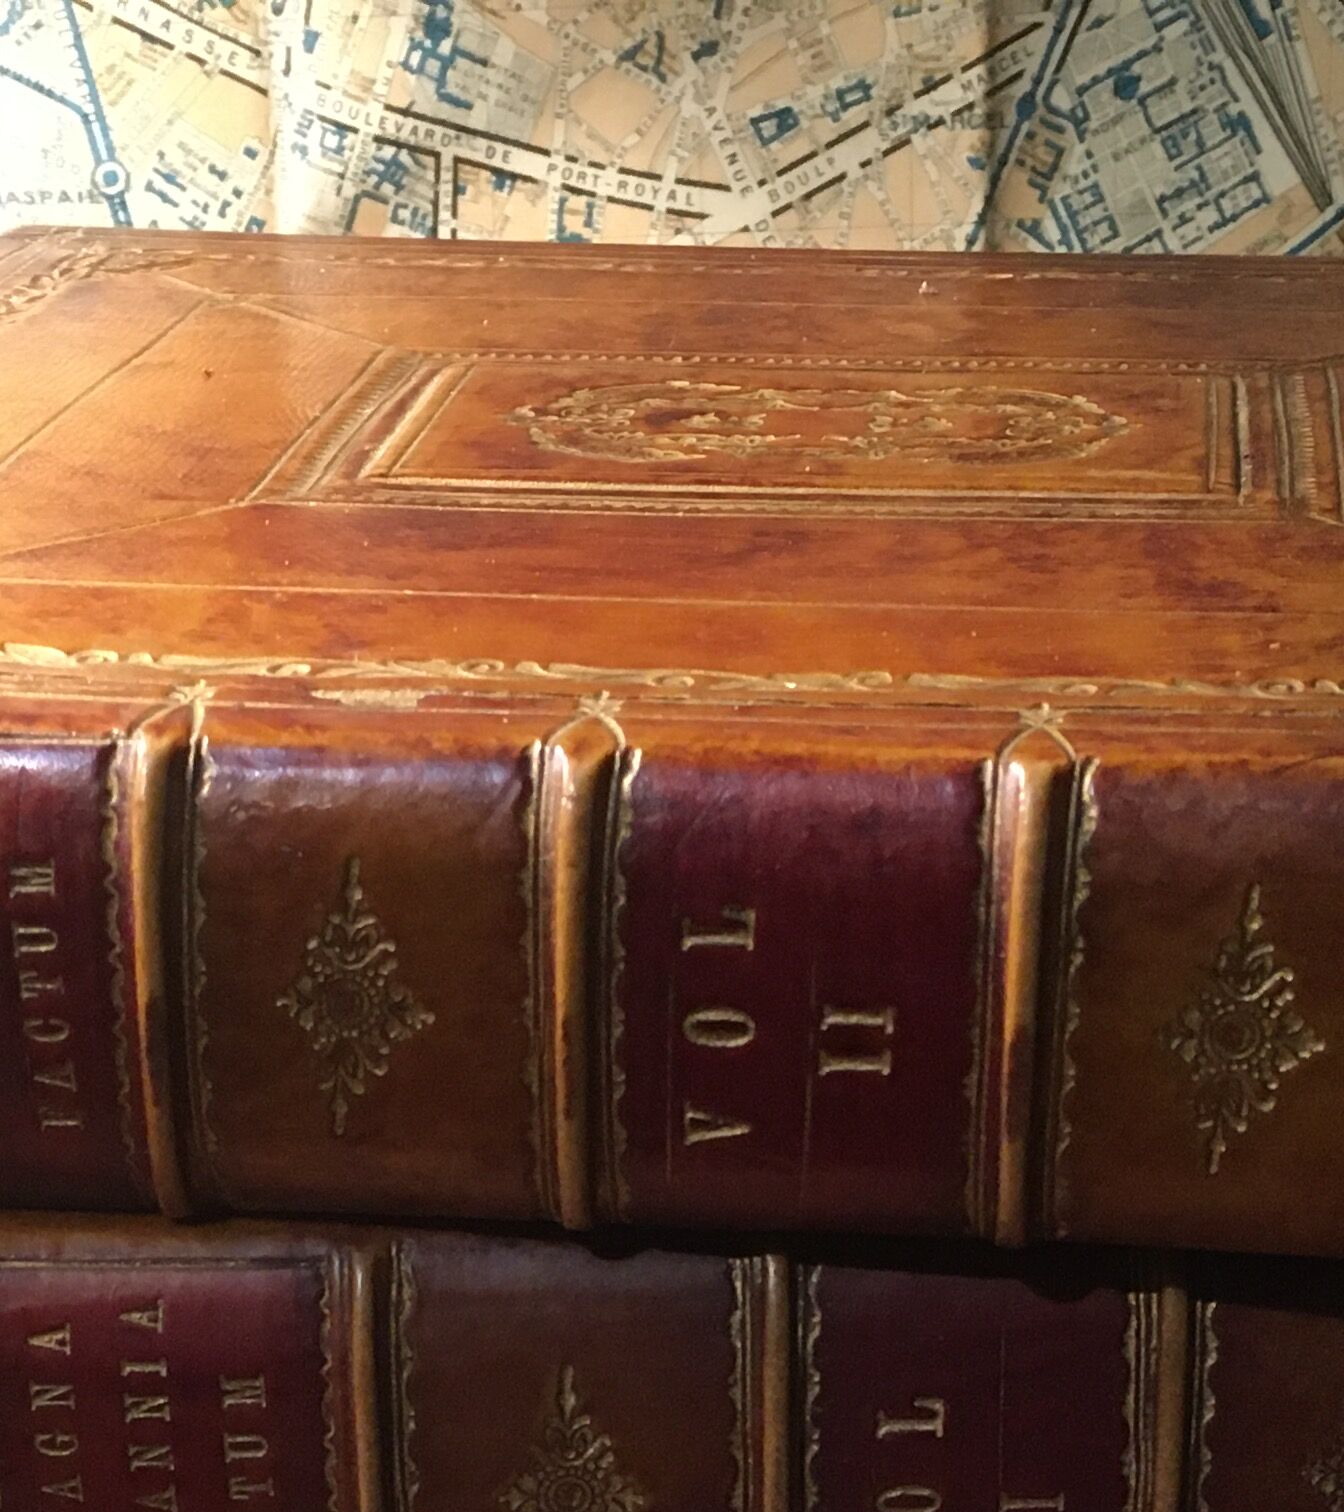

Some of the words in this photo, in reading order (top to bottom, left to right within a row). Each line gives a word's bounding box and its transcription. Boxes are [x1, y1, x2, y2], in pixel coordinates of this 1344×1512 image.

[484, 145, 512, 165] DE
[545, 161, 696, 208] PORT-ROYAL
[703, 104, 755, 199] AVENUE
[8, 857, 86, 1132] FACTUM
[680, 907, 756, 1147] VOL
[817, 1004, 897, 1077] II
